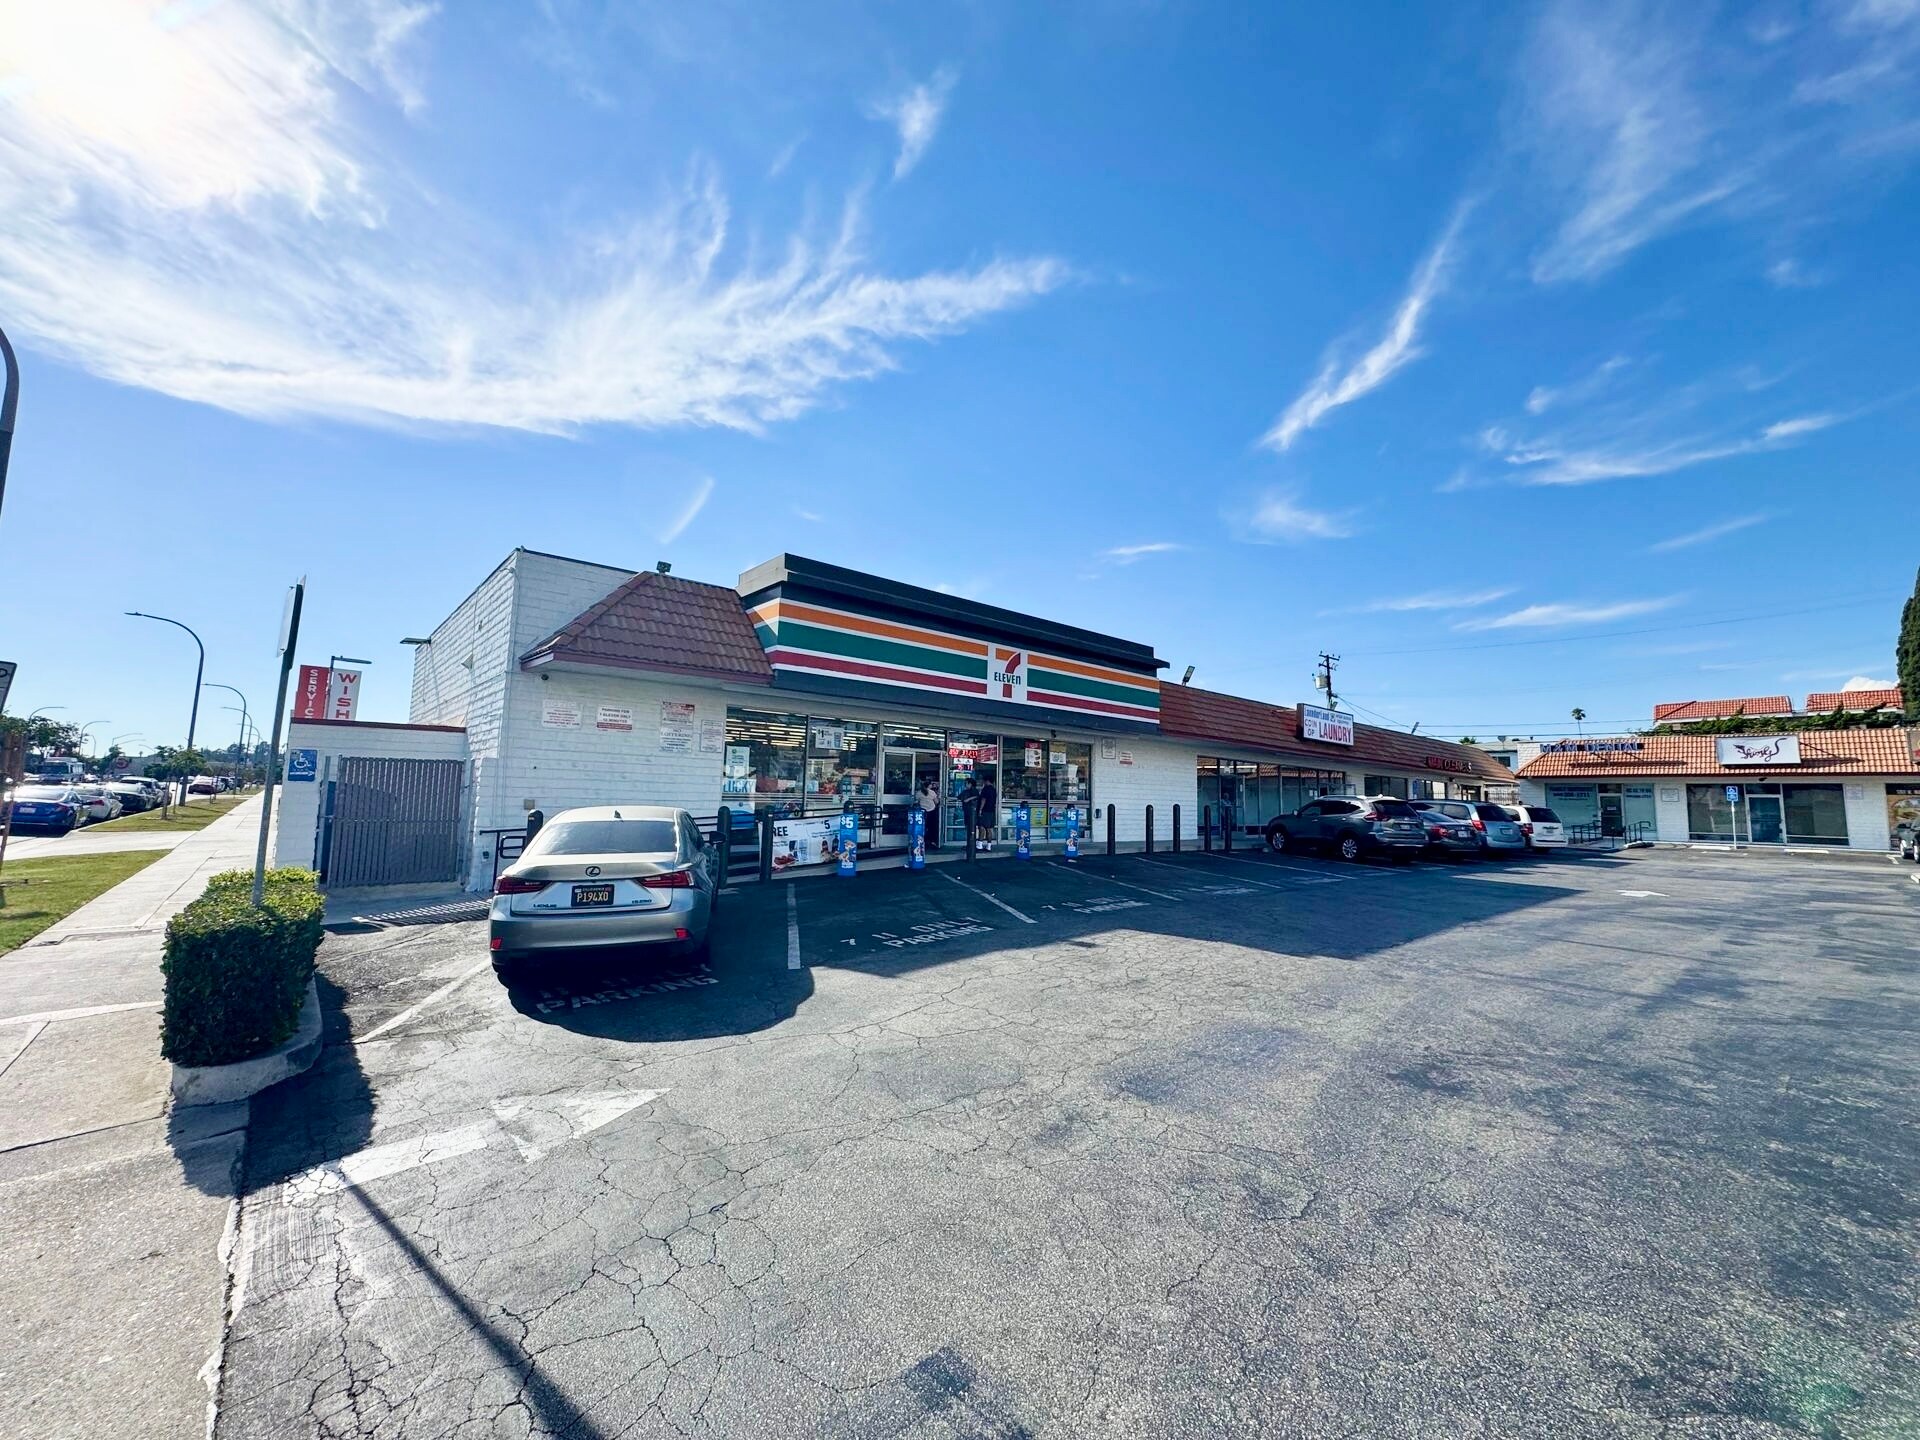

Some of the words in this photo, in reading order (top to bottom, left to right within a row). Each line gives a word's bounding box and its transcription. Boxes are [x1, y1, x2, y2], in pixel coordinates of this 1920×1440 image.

[996, 648, 1020, 698] 7
[305, 669, 318, 719] SERVIC
[336, 673, 357, 719] WISH
[1305, 719, 1317, 728] COIN
[1319, 722, 1351, 743] LAUNDRY
[1585, 742, 1638, 752] DENTAL
[841, 816, 854, 829] $5
[1018, 811, 1028, 821] $5
[1068, 811, 1078, 821] $5
[773, 826, 789, 837] REE
[883, 925, 995, 948] PARKING
[536, 975, 719, 1013] PARKING
